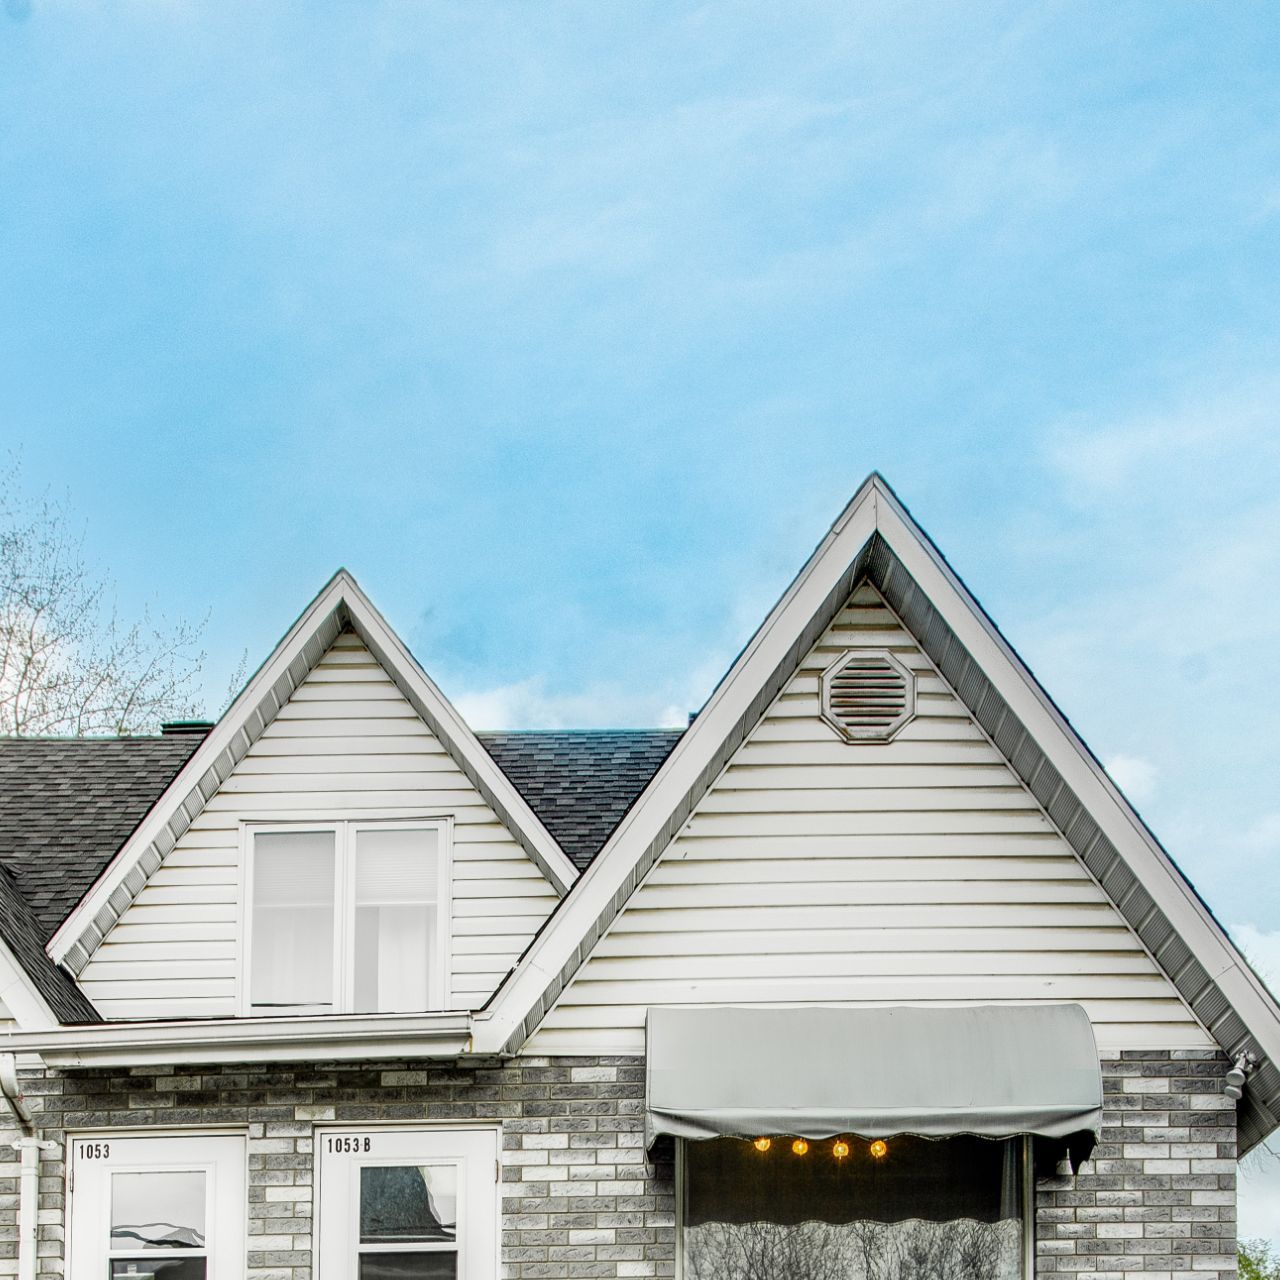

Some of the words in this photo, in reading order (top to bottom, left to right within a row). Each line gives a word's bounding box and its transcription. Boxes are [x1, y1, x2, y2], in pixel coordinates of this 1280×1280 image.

[79, 1143, 110, 1160] 1053
[328, 1137, 359, 1153] 1053
[364, 1137, 371, 1152] B
